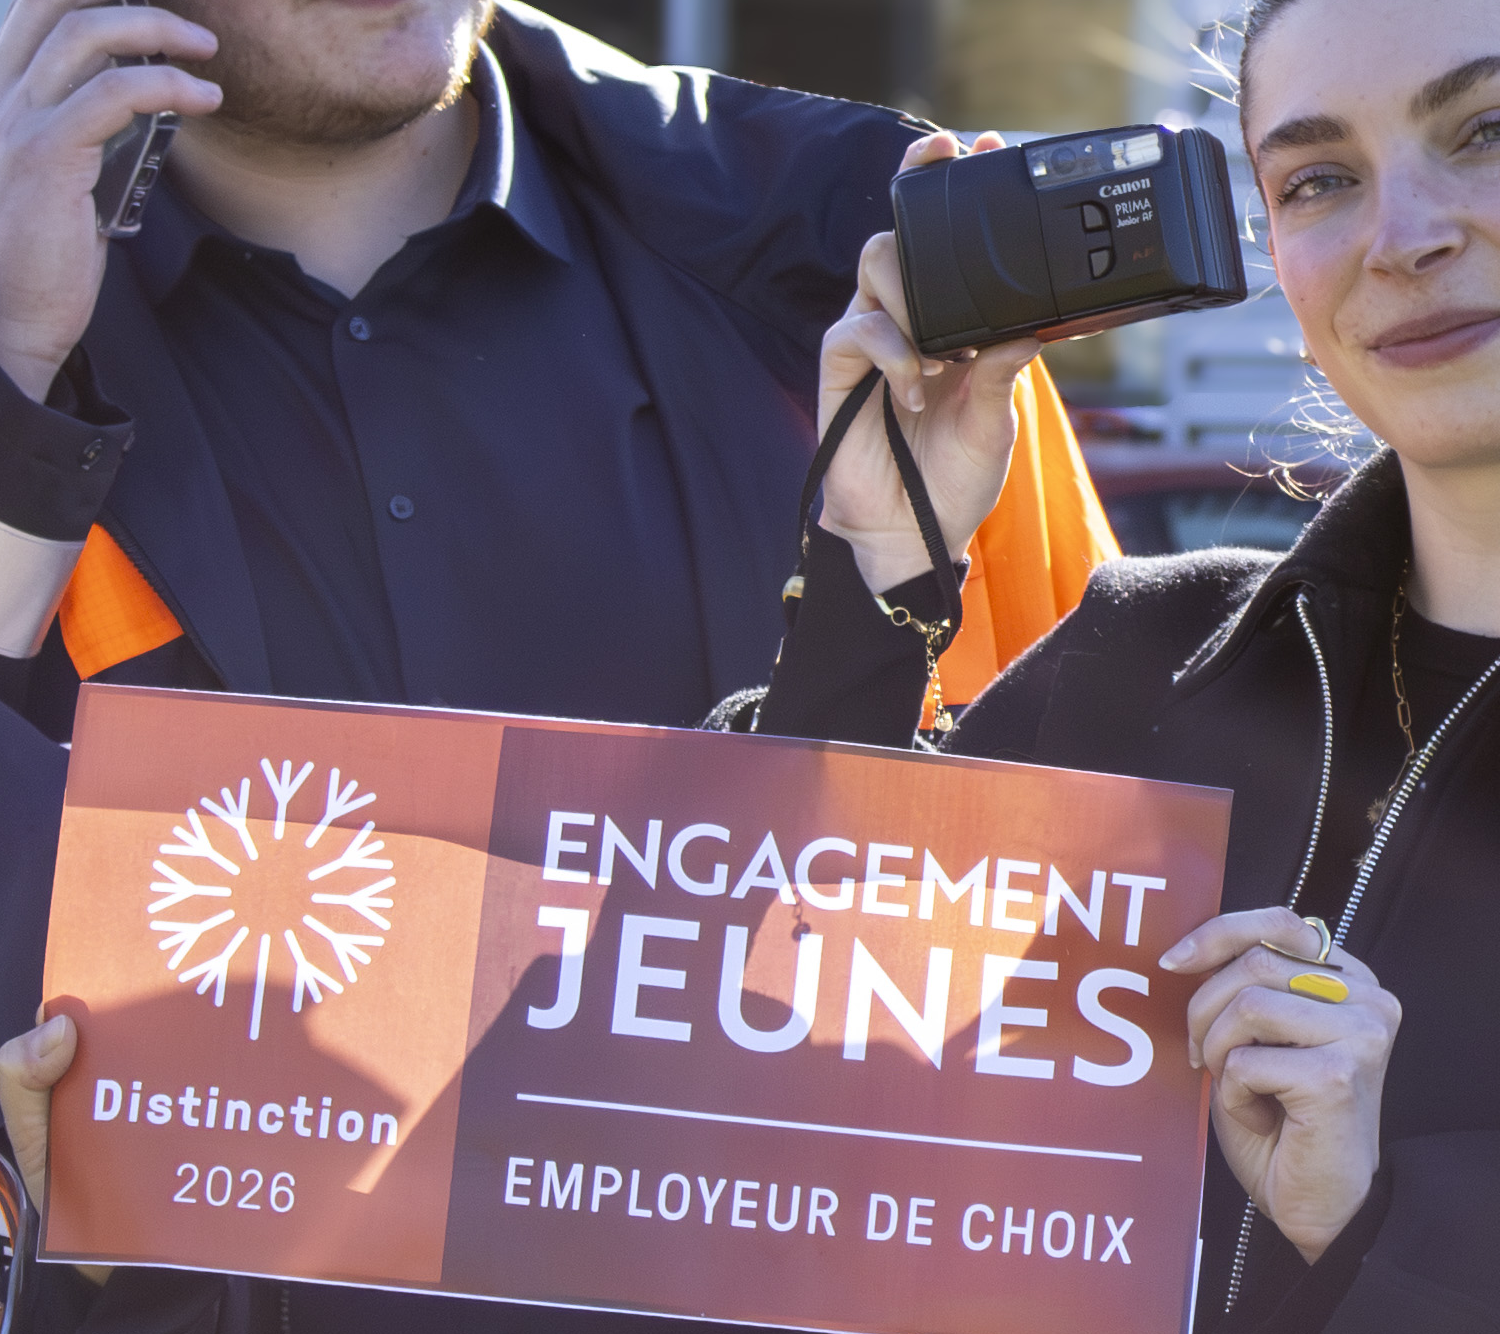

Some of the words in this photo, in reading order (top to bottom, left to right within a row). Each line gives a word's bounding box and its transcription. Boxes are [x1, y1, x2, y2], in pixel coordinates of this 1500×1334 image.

[1099, 177, 1152, 199] Canon
[1114, 197, 1152, 216] PRIMA
[540, 808, 1167, 948] ENGAGEMENT
[526, 904, 1156, 1090] JEUNES
[93, 1077, 401, 1147] Distinction
[171, 1160, 298, 1215] 2026
[504, 1154, 839, 1238] EMPLOYEUR
[865, 1191, 935, 1247] DE
[960, 1202, 1137, 1267] CHOIX
